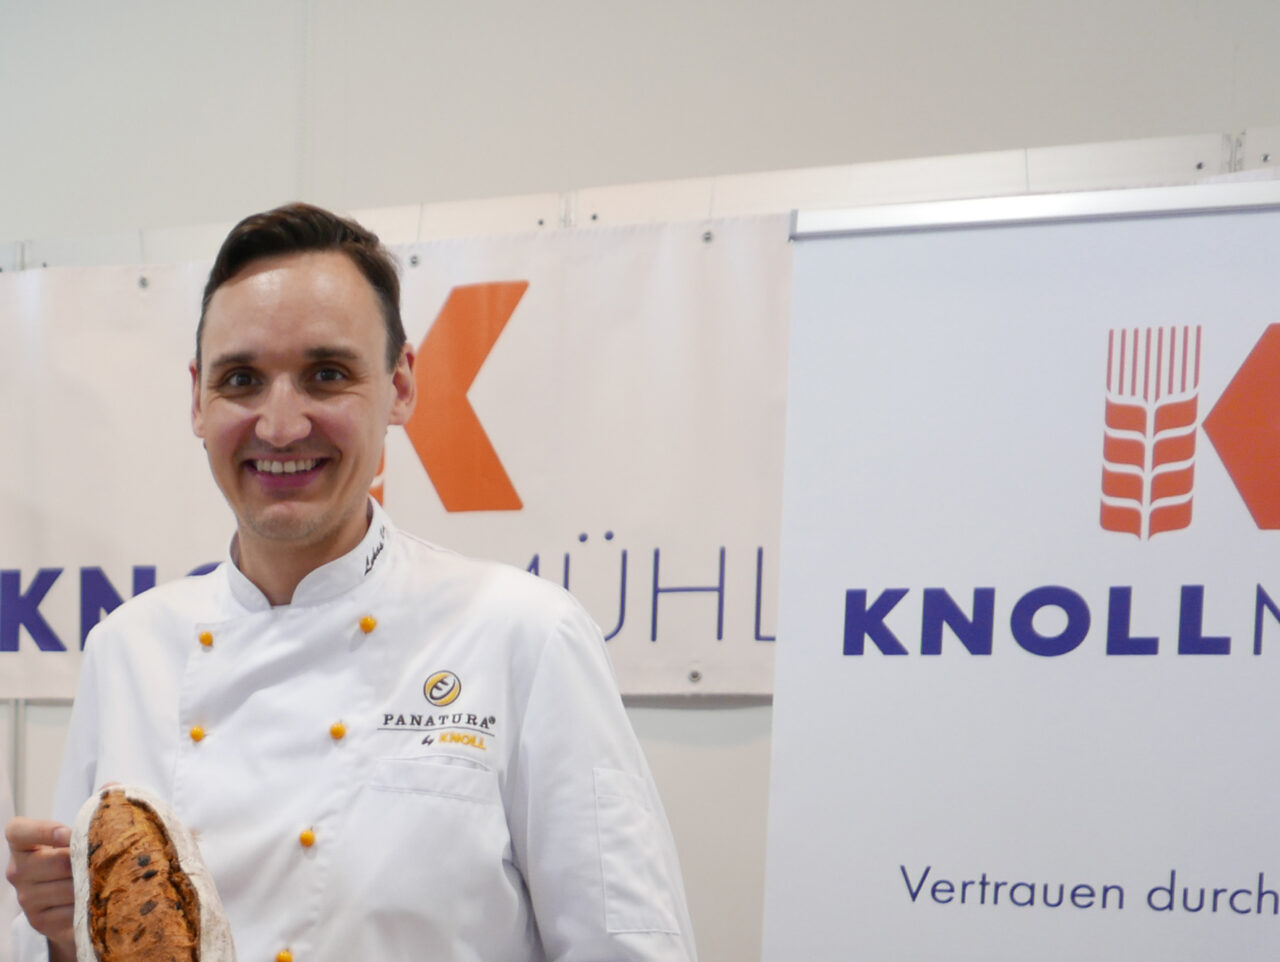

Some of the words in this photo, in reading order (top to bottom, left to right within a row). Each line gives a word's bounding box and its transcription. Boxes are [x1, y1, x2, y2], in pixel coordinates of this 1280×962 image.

[438, 731, 488, 751] KNOLL
[899, 864, 1125, 910] Vertrauen
[1146, 868, 1280, 916] durch
